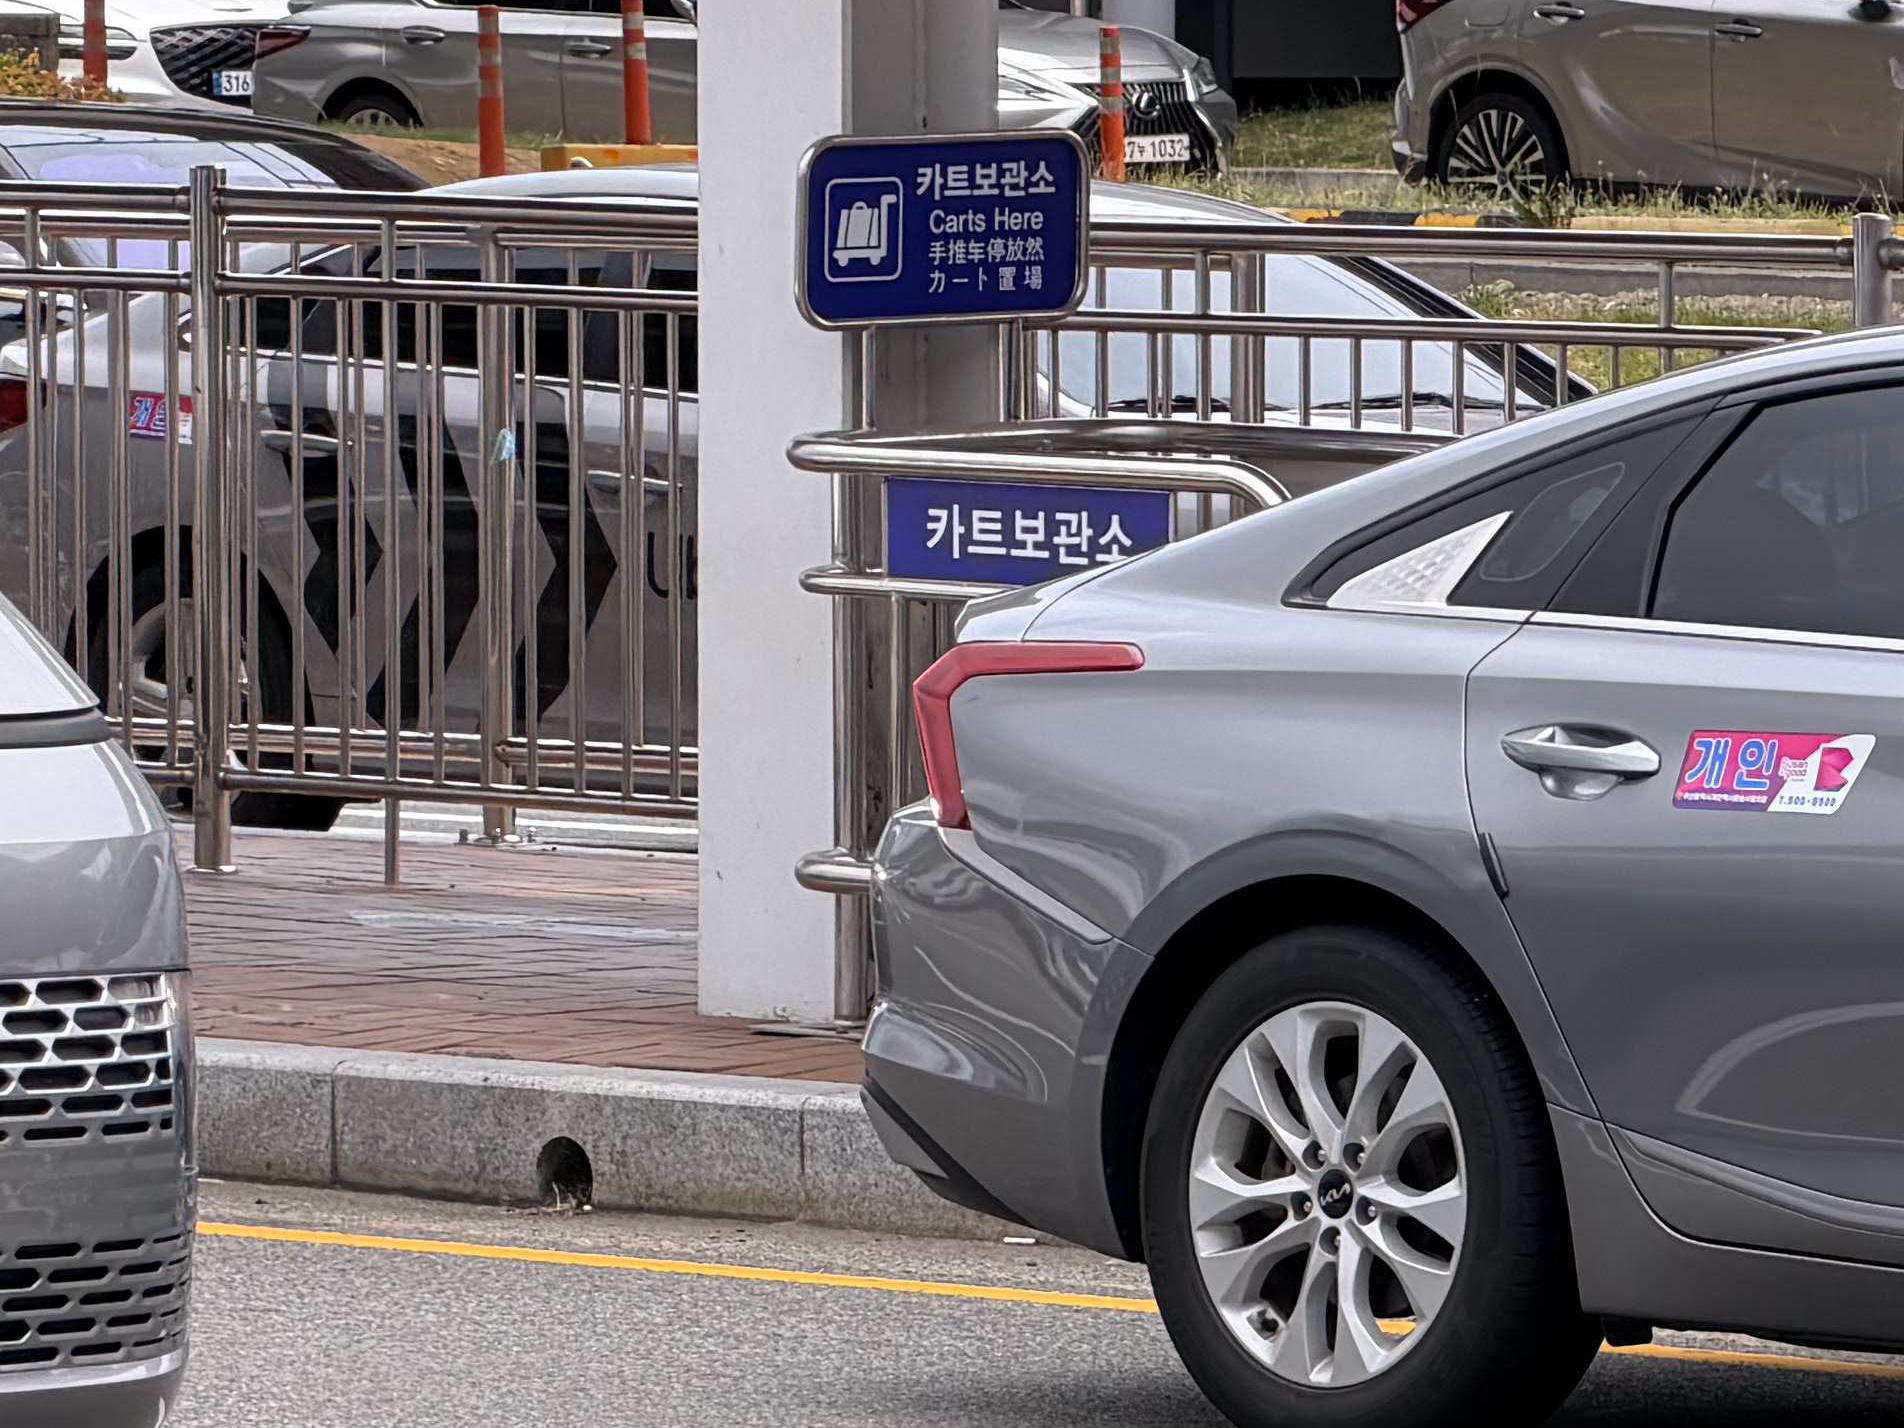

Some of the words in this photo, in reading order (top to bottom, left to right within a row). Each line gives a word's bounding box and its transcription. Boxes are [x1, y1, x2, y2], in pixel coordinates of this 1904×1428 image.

[916, 160, 1056, 201] 카트보관소
[929, 208, 986, 235] Carts
[994, 206, 1044, 232] Here
[926, 503, 1133, 566] 카트보관소
